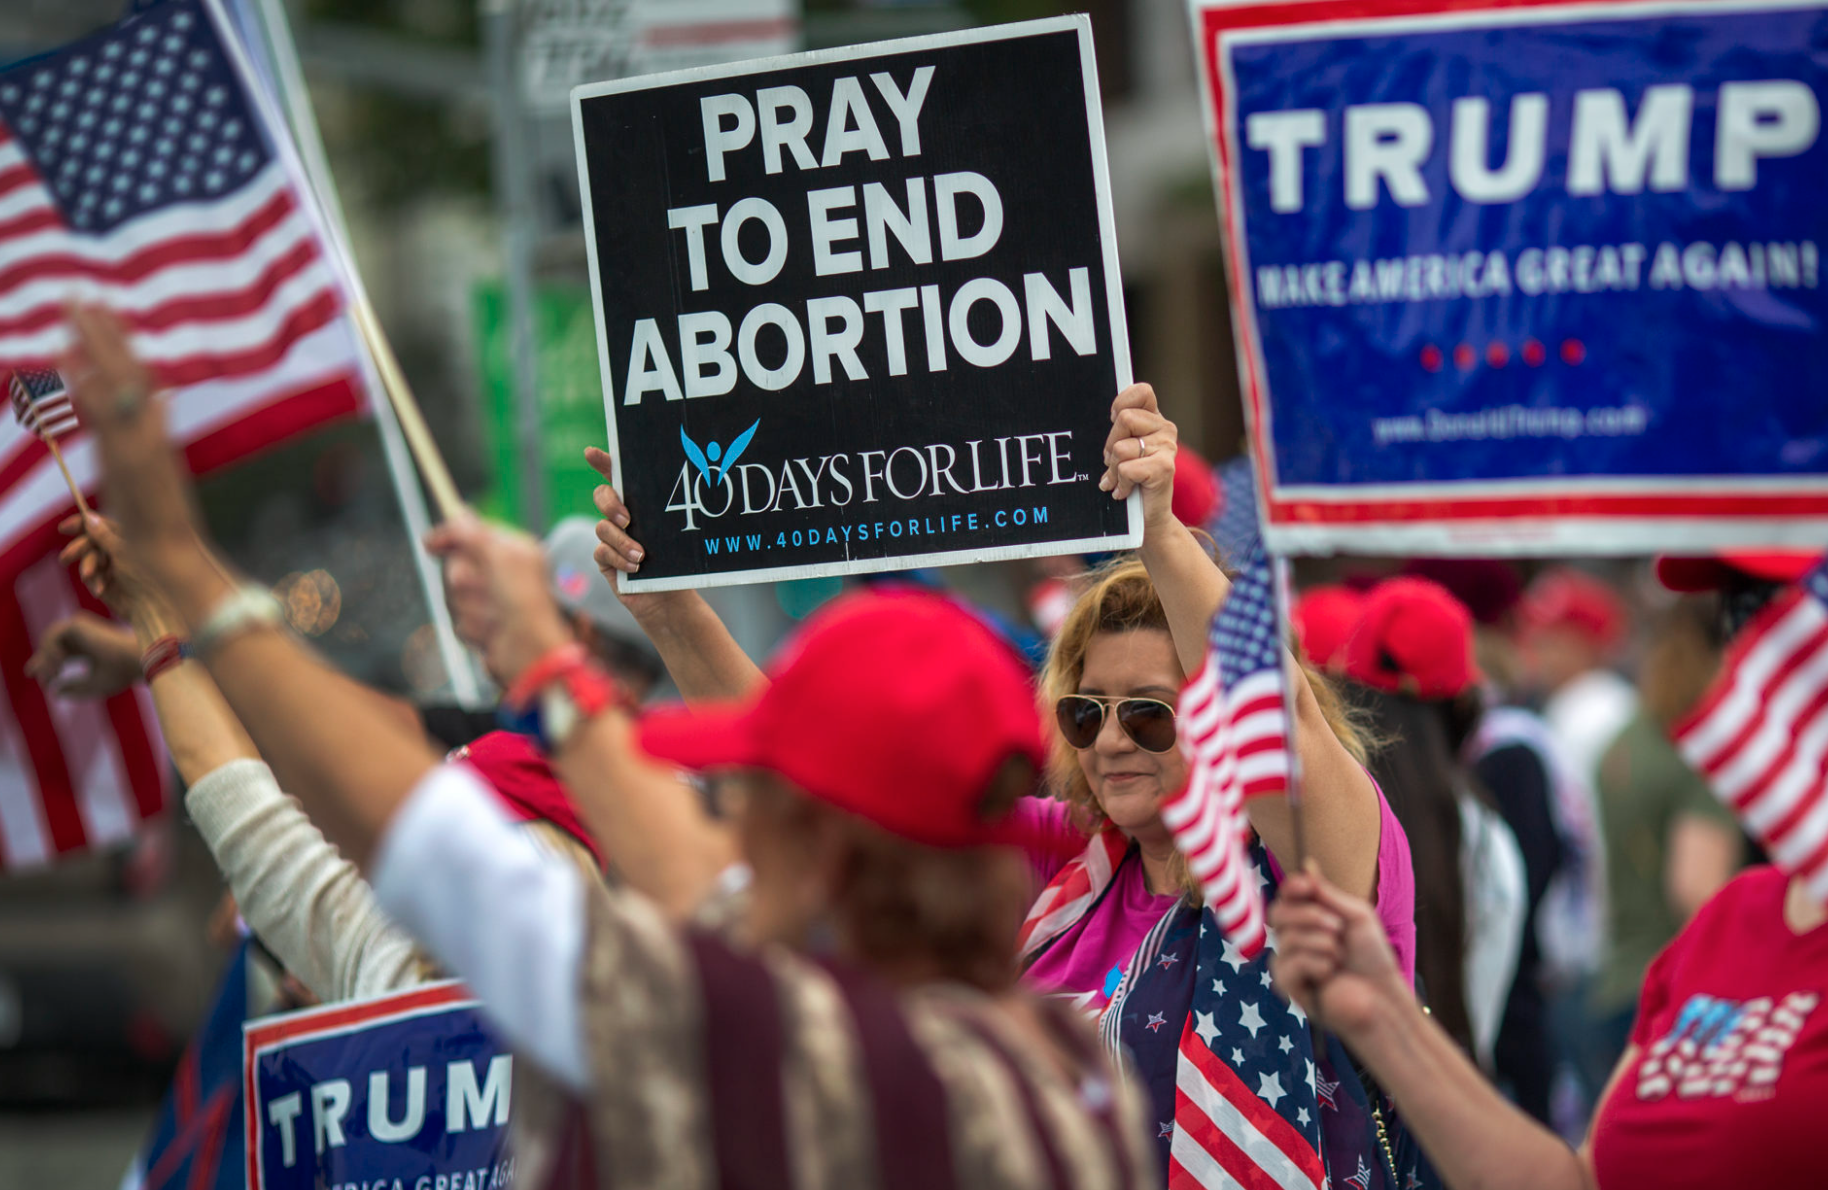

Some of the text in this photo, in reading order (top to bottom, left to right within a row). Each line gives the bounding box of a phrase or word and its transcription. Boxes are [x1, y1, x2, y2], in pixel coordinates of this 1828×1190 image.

[700, 65, 936, 183] PRAY
[1247, 79, 1821, 213] TRUMP
[667, 171, 1004, 292] TO END
[1257, 240, 1818, 309] MAKE AMERICA GREAT AGAIN!
[623, 267, 1097, 406] ABORTION
[704, 506, 1049, 555] WWW.40DAYSFORLIFE.COM
[736, 453, 853, 516] DAYS
[857, 444, 970, 503] FOR
[268, 1053, 513, 1168] TRUM
